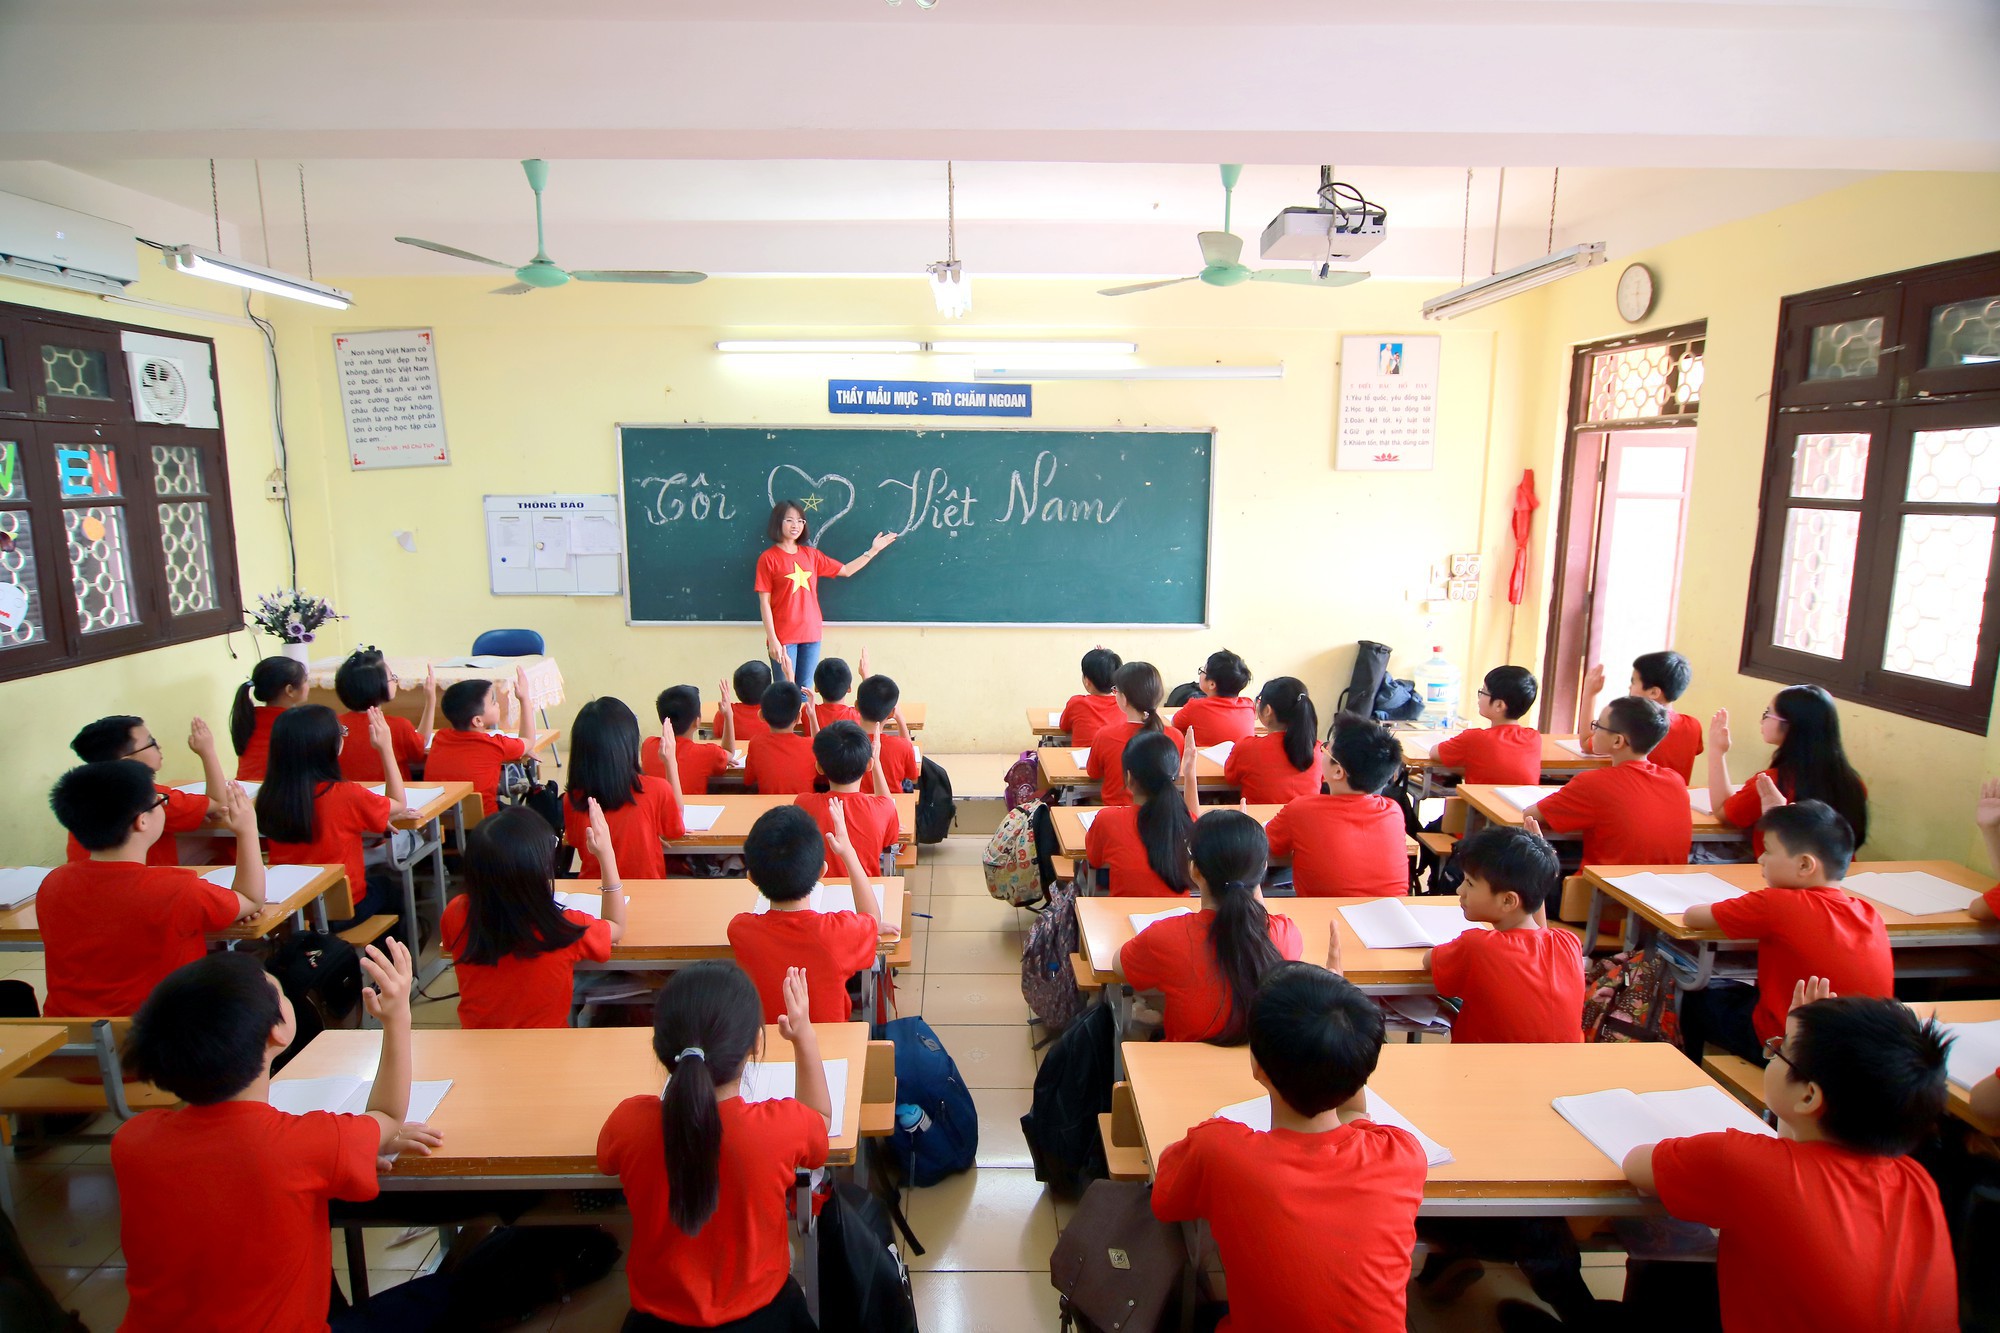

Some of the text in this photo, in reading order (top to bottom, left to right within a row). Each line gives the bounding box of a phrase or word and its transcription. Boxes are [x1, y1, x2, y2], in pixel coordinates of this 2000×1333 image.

[836, 385, 864, 405] THẦY
[866, 385, 891, 405] MẪU
[894, 390, 919, 409] MỰC
[931, 389, 952, 407] TRÒ
[955, 389, 986, 408] CHĂM
[988, 393, 1027, 408] NGOAN
[517, 500, 584, 508] THÔNG BÁO
[640, 450, 1126, 537] Tôi Việt Nam
